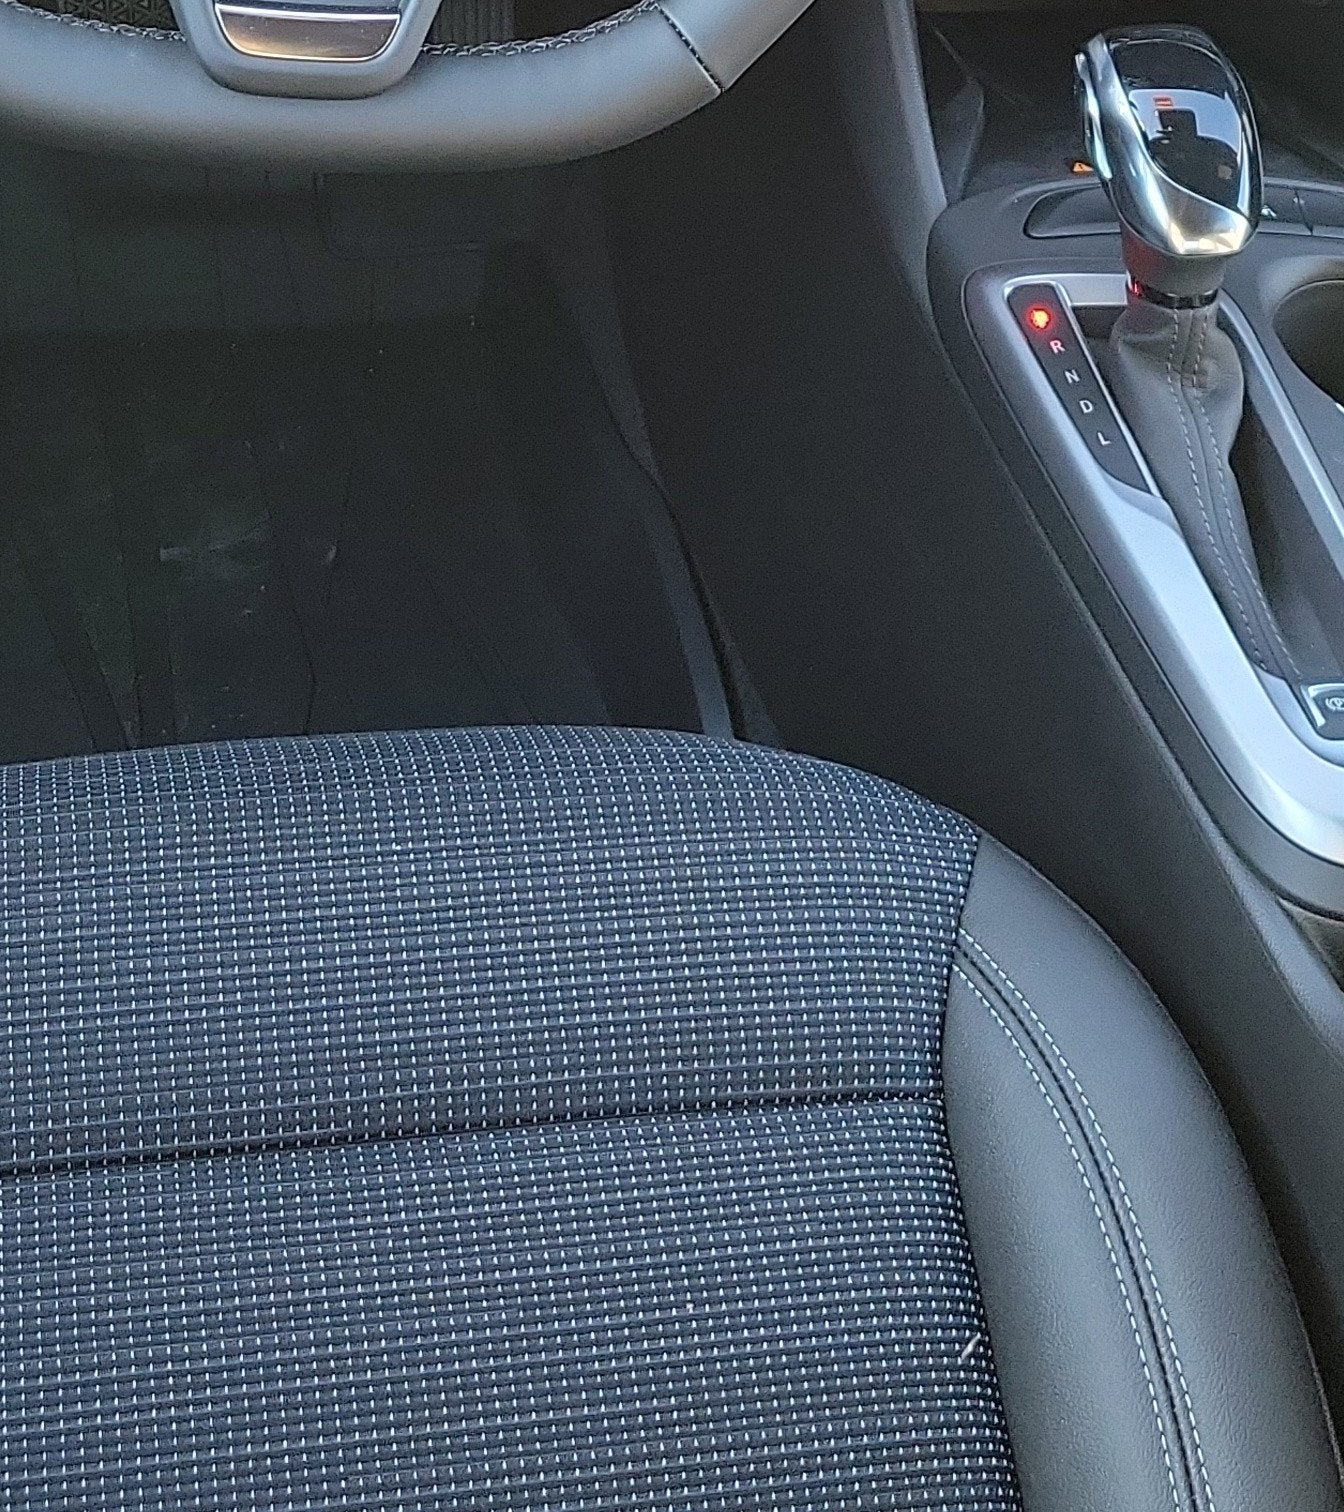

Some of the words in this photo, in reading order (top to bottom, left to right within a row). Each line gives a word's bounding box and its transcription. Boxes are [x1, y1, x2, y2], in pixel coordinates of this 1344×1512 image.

[1049, 339, 1066, 354] R
[1064, 369, 1080, 384] N
[1079, 399, 1093, 414] D
[1097, 432, 1112, 446] L
